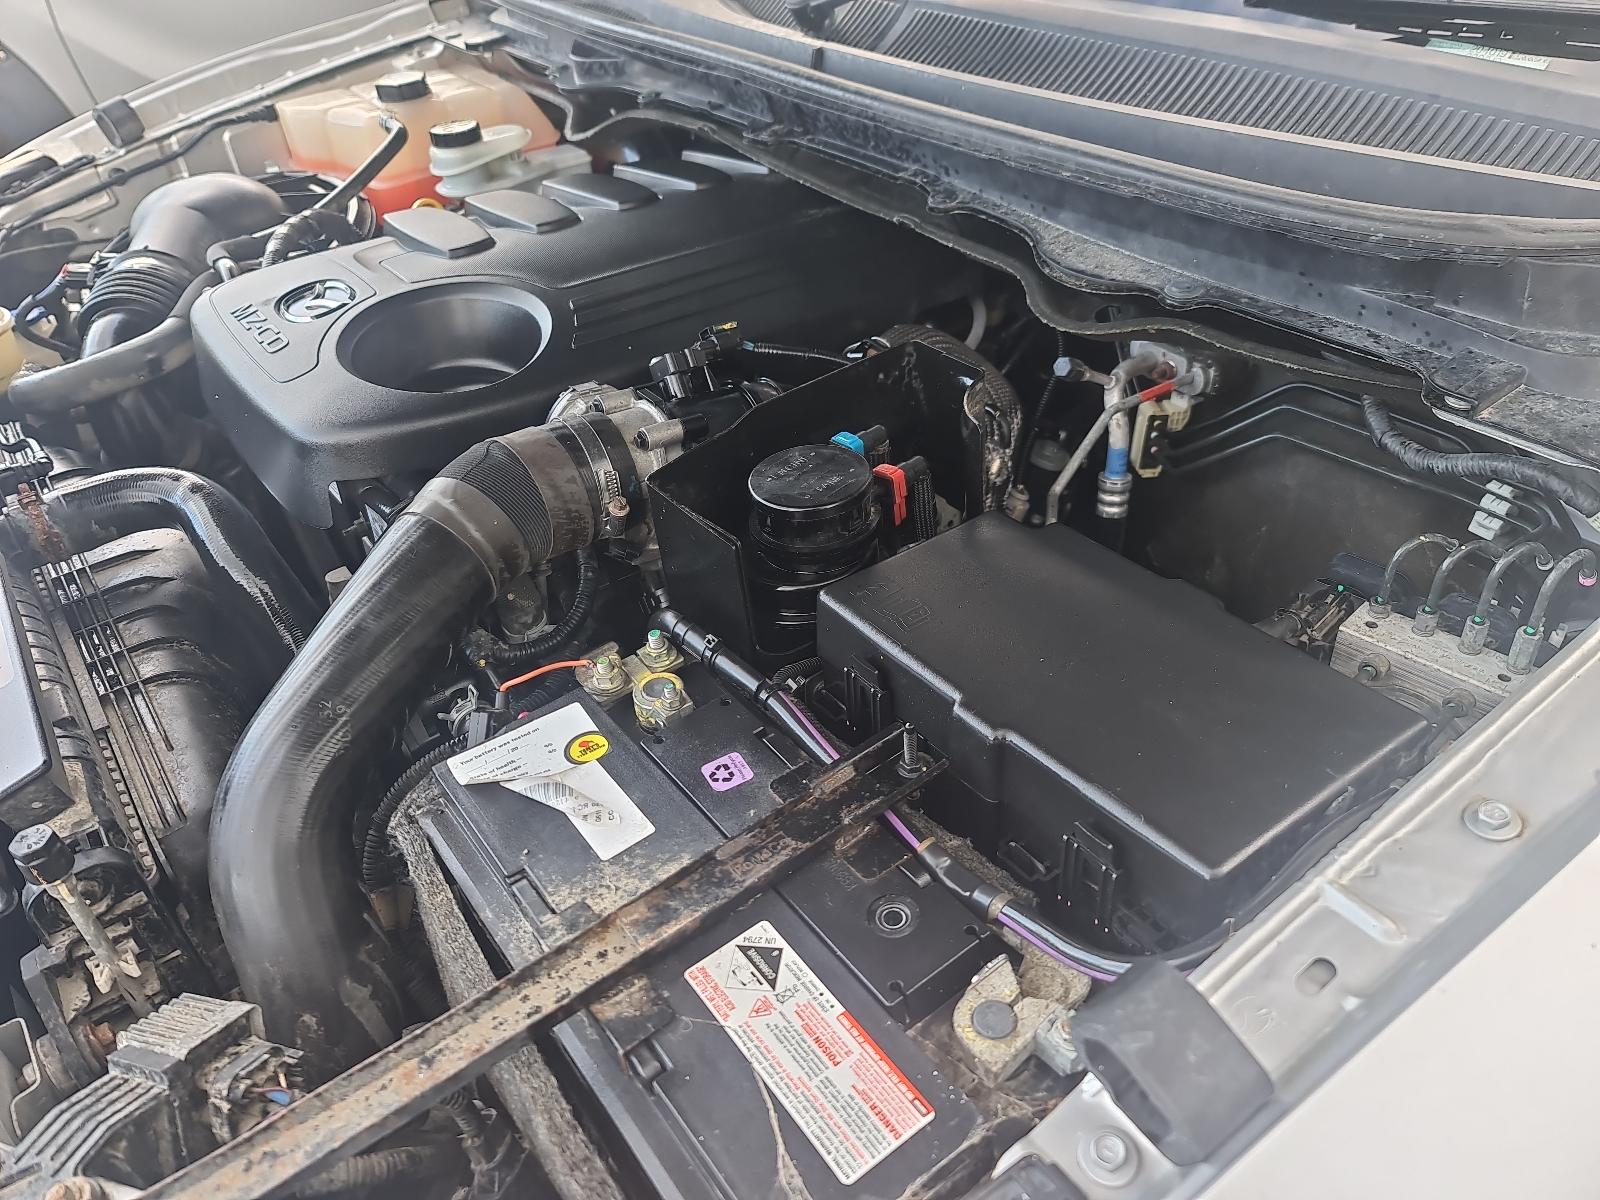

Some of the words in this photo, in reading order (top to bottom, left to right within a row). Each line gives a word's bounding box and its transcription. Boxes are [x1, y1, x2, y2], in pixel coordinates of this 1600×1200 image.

[230, 304, 289, 354] MZ-CD
[475, 747, 497, 759] battery
[511, 732, 531, 742] tested
[742, 936, 762, 944] 2794
[764, 937, 777, 945] UN
[746, 947, 776, 979] CORROSIVE
[790, 983, 801, 993] Pb
[811, 1034, 841, 1067] POISON
[868, 1101, 903, 1140] DANGER
